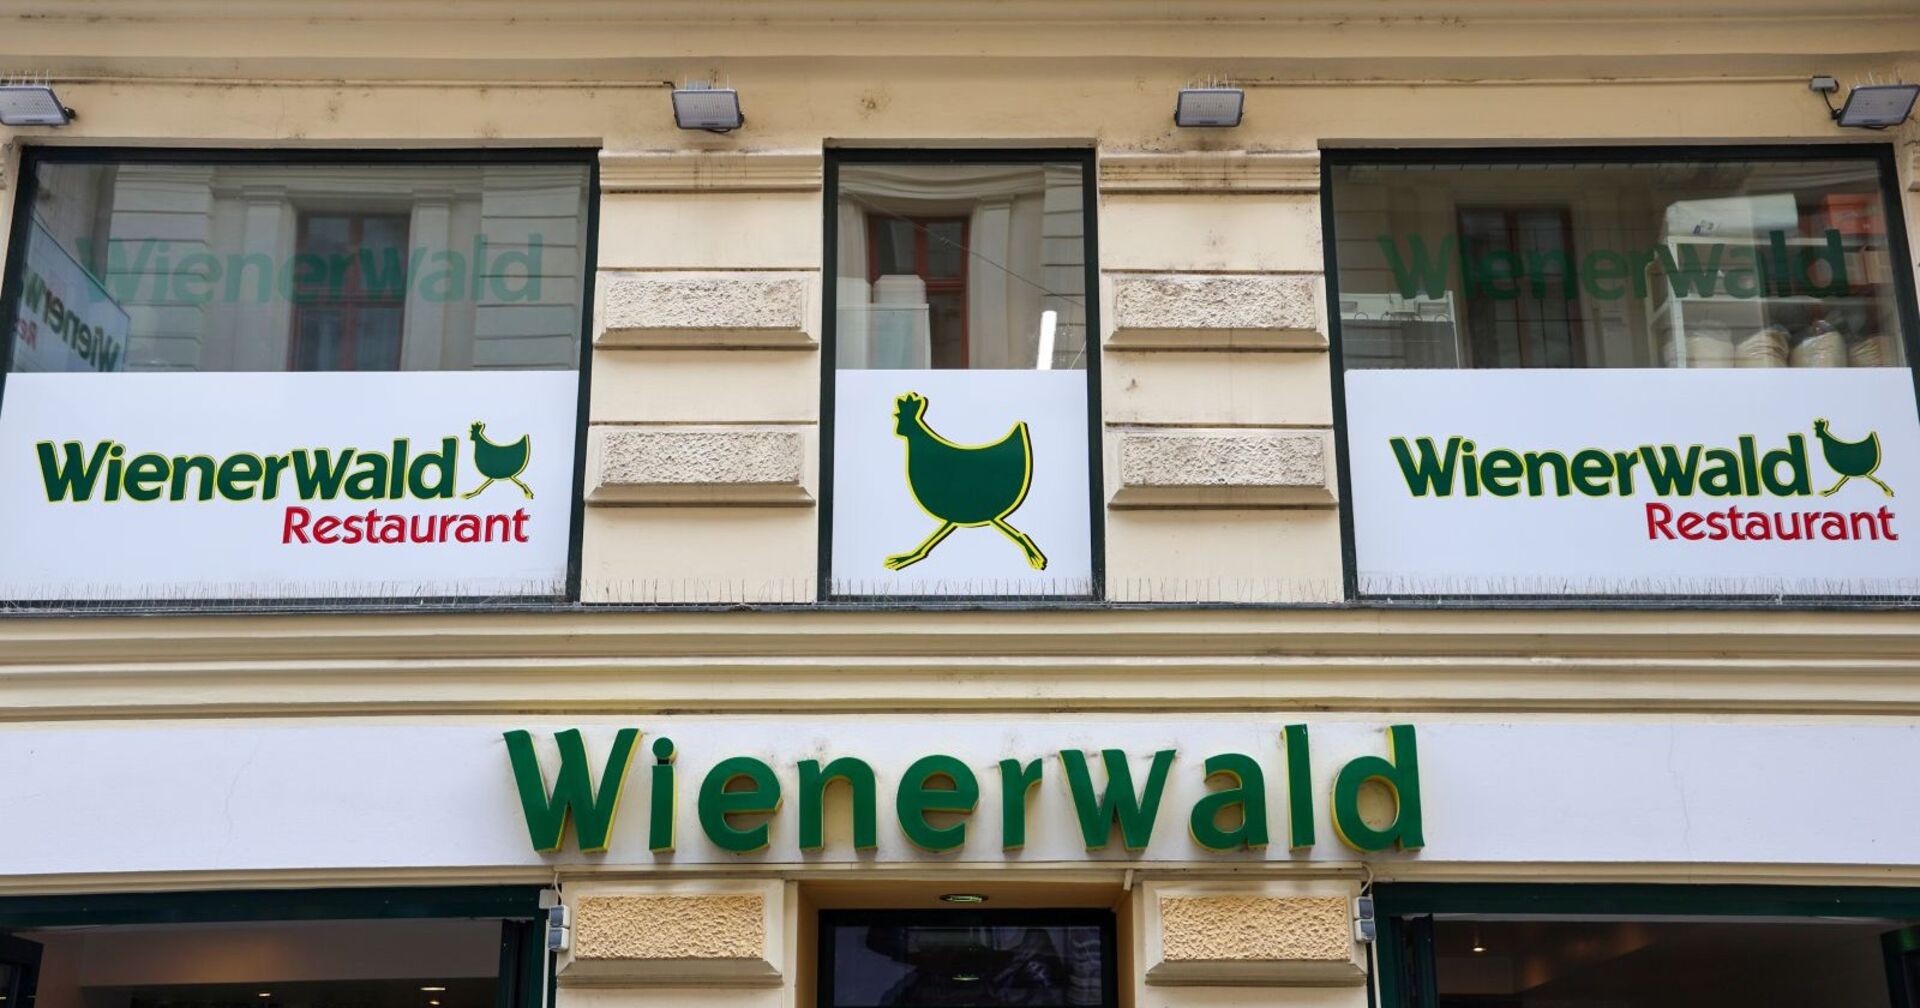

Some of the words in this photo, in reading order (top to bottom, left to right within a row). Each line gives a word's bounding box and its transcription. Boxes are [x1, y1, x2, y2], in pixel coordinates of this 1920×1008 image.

[75, 233, 544, 303] Wienerwald
[1376, 229, 1849, 300] Wienerwald
[36, 438, 459, 502] Wienerwald
[1389, 434, 1811, 497] Wienerwald
[282, 506, 530, 544] Restaurant
[1646, 502, 1899, 541] Restaurant
[503, 723, 1425, 854] Wienerwald
